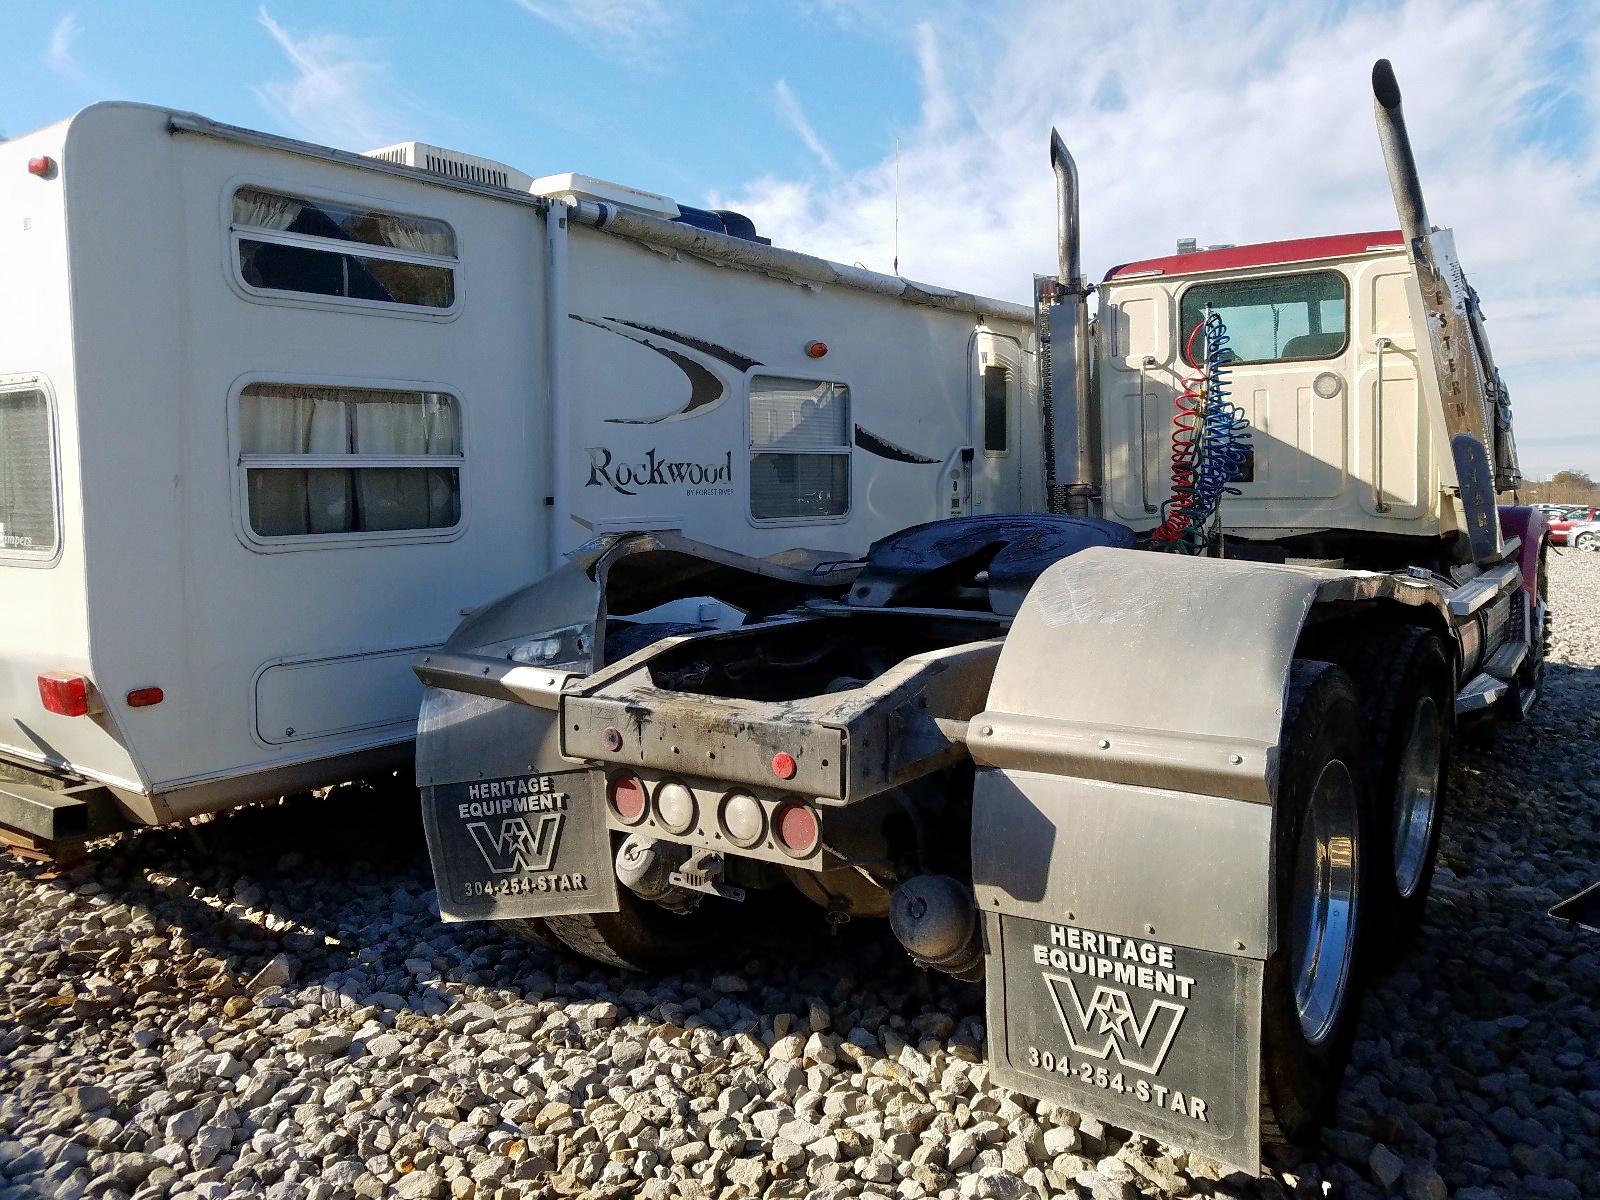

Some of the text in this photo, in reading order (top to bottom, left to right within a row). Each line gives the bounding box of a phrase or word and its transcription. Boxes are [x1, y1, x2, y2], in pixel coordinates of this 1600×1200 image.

[584, 446, 733, 496] Rockwood
[686, 488, 735, 497] BY FOREST RIVER
[458, 792, 566, 819] EQUIPMENT
[469, 775, 550, 800] HERITAGE
[464, 872, 585, 897] 304-254-STAR
[1050, 924, 1175, 969] HERITAGE
[1033, 944, 1195, 999] EQUIPMENT
[1028, 1046, 1208, 1123] 304-254-STAR
